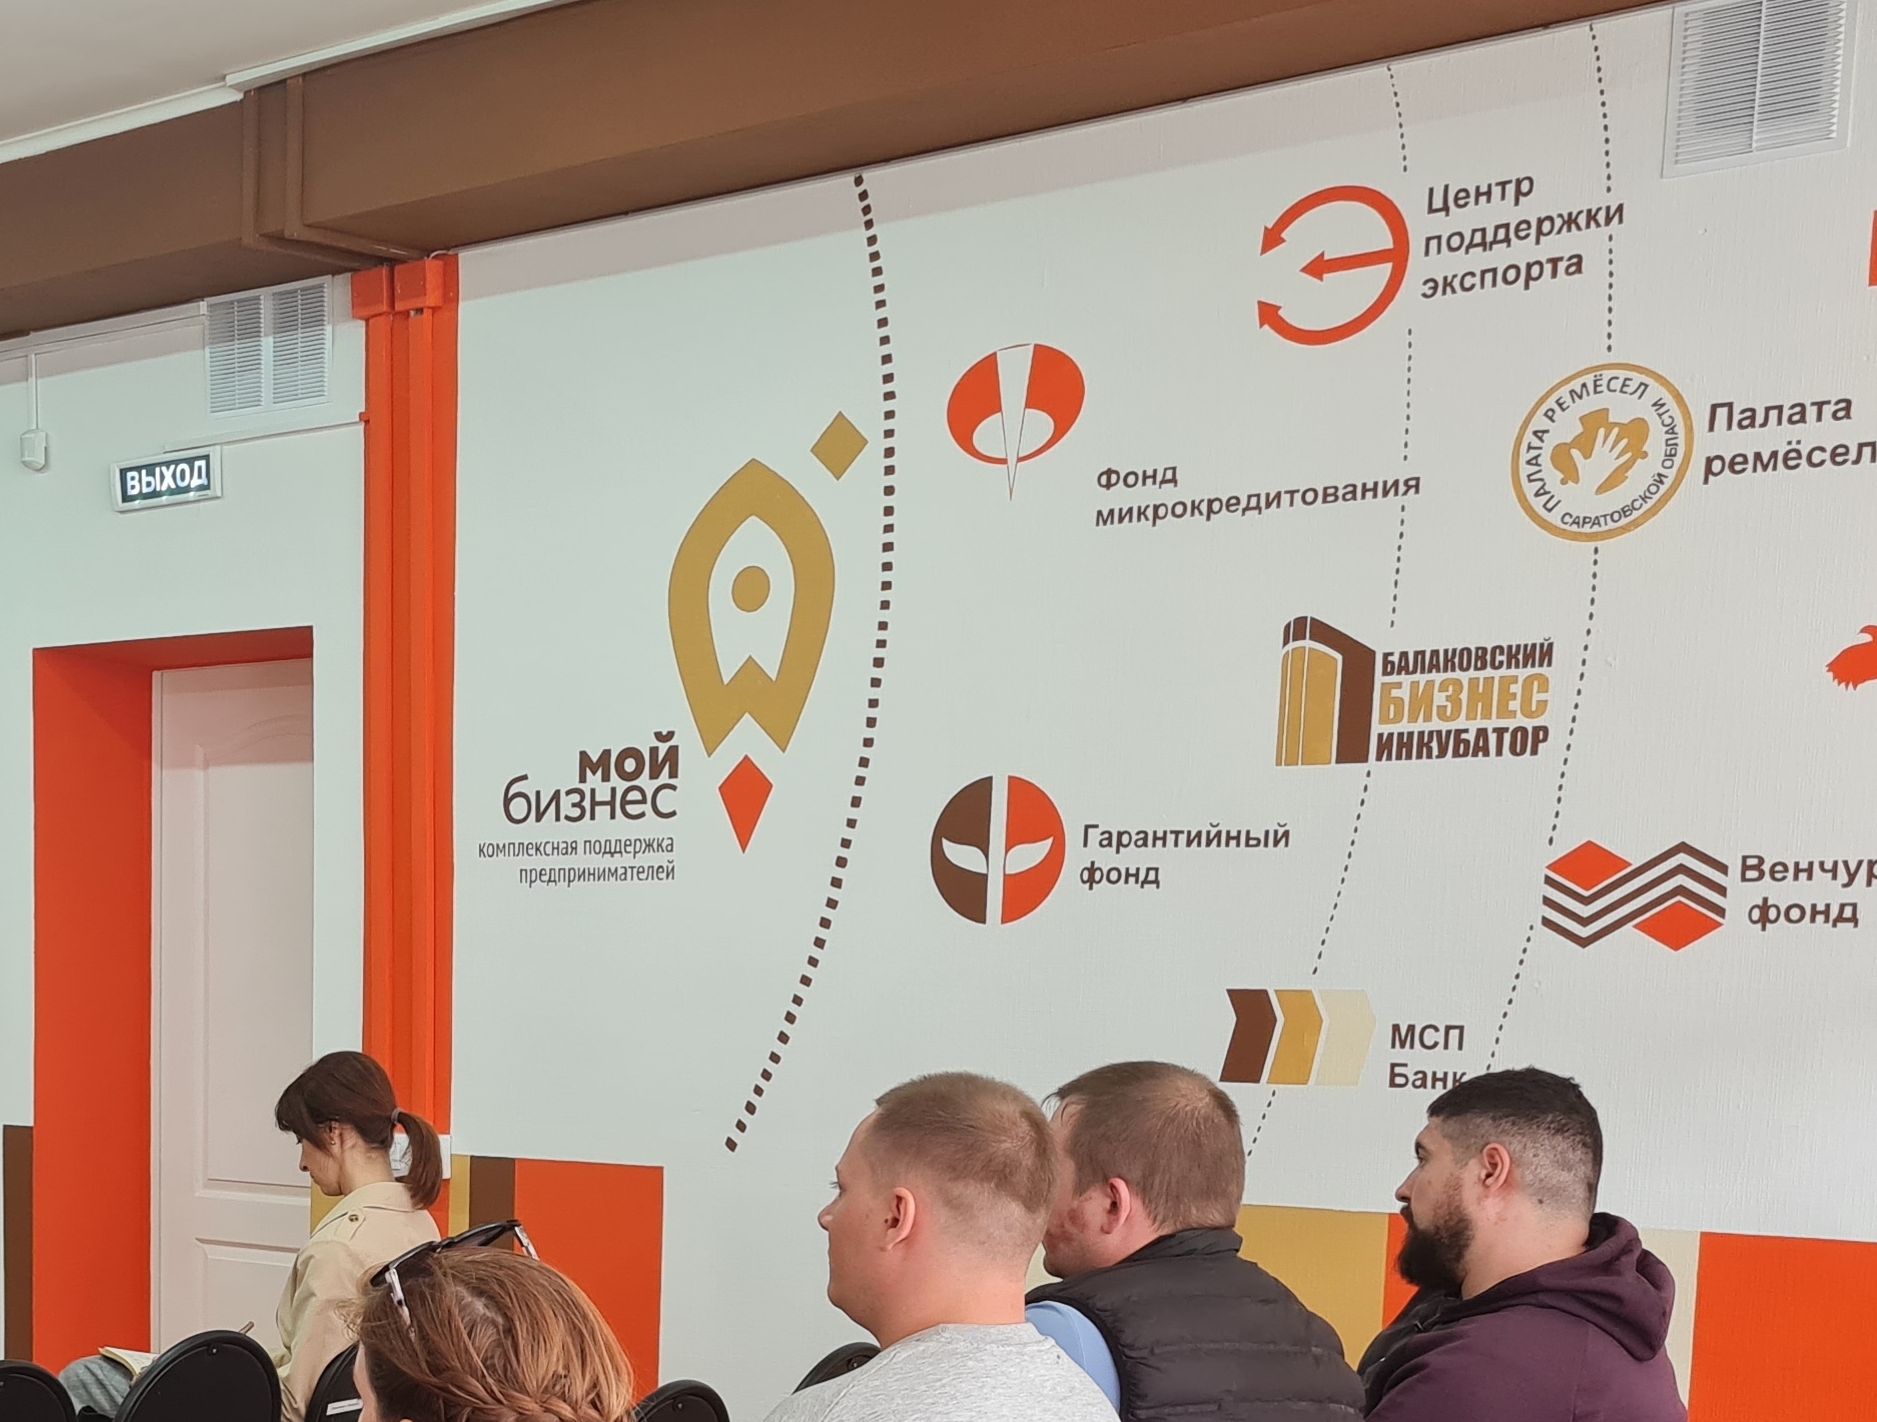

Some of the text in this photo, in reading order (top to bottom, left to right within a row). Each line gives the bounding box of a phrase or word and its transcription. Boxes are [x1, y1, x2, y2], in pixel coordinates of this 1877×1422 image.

[1426, 176, 1535, 217] Центр
[1424, 202, 1625, 258] поддержки
[1420, 253, 1584, 300] экспорта
[1707, 397, 1853, 433] Палата
[1525, 373, 1650, 514] ПАЛАТА РЕМЁСЕЛ
[1560, 397, 1680, 530] САРАТОВСКОЙ ОБЛАСТИ
[1702, 438, 1877, 485] ремёсел
[126, 459, 208, 496] ВЫХОД
[1096, 466, 1179, 491] Фонд
[1095, 476, 1421, 527] микрокредитования
[1381, 636, 1555, 677] БАЛАКОВСКИЙ
[1378, 673, 1550, 725] БИЗНЕС
[578, 730, 680, 784] мой
[1375, 725, 1550, 762] ИНКУБАТОР
[502, 773, 679, 825] бизнес
[478, 836, 675, 860] комплексная поддержка
[1082, 822, 1291, 855] Гарантийный
[519, 859, 676, 889] предпринимателей
[1079, 860, 1161, 891] фонд
[1747, 896, 1859, 932] фонд
[1390, 1023, 1465, 1051] МСП
